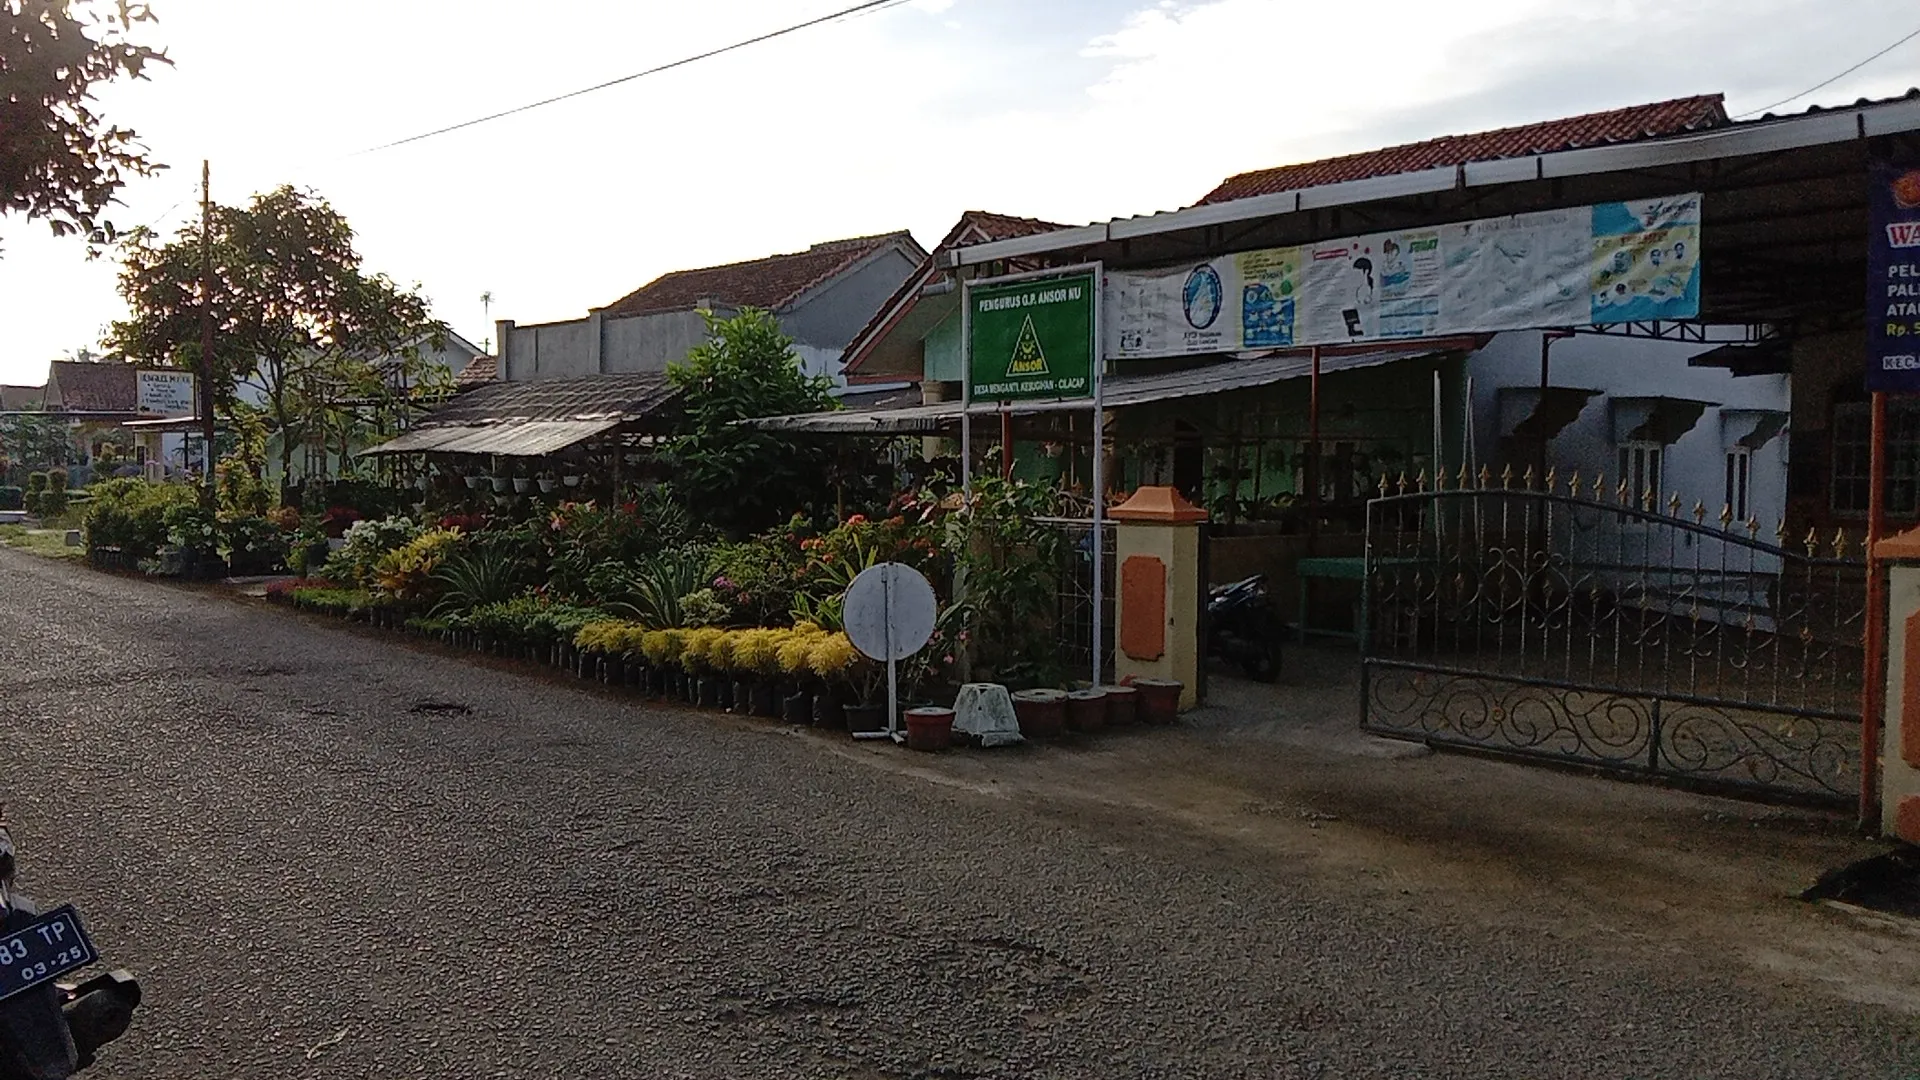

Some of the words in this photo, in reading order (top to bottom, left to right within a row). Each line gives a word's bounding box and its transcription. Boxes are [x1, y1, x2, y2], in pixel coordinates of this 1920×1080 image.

[979, 295, 1021, 312] PENGURUS
[1038, 289, 1067, 304] ANSOR
[1068, 287, 1082, 301] NU
[1887, 283, 1920, 297] PAL
[1886, 302, 1920, 316] ATA
[1012, 358, 1043, 373] ANSOR
[37, 921, 65, 946] TP
[22, 945, 81, 981] 03.25
